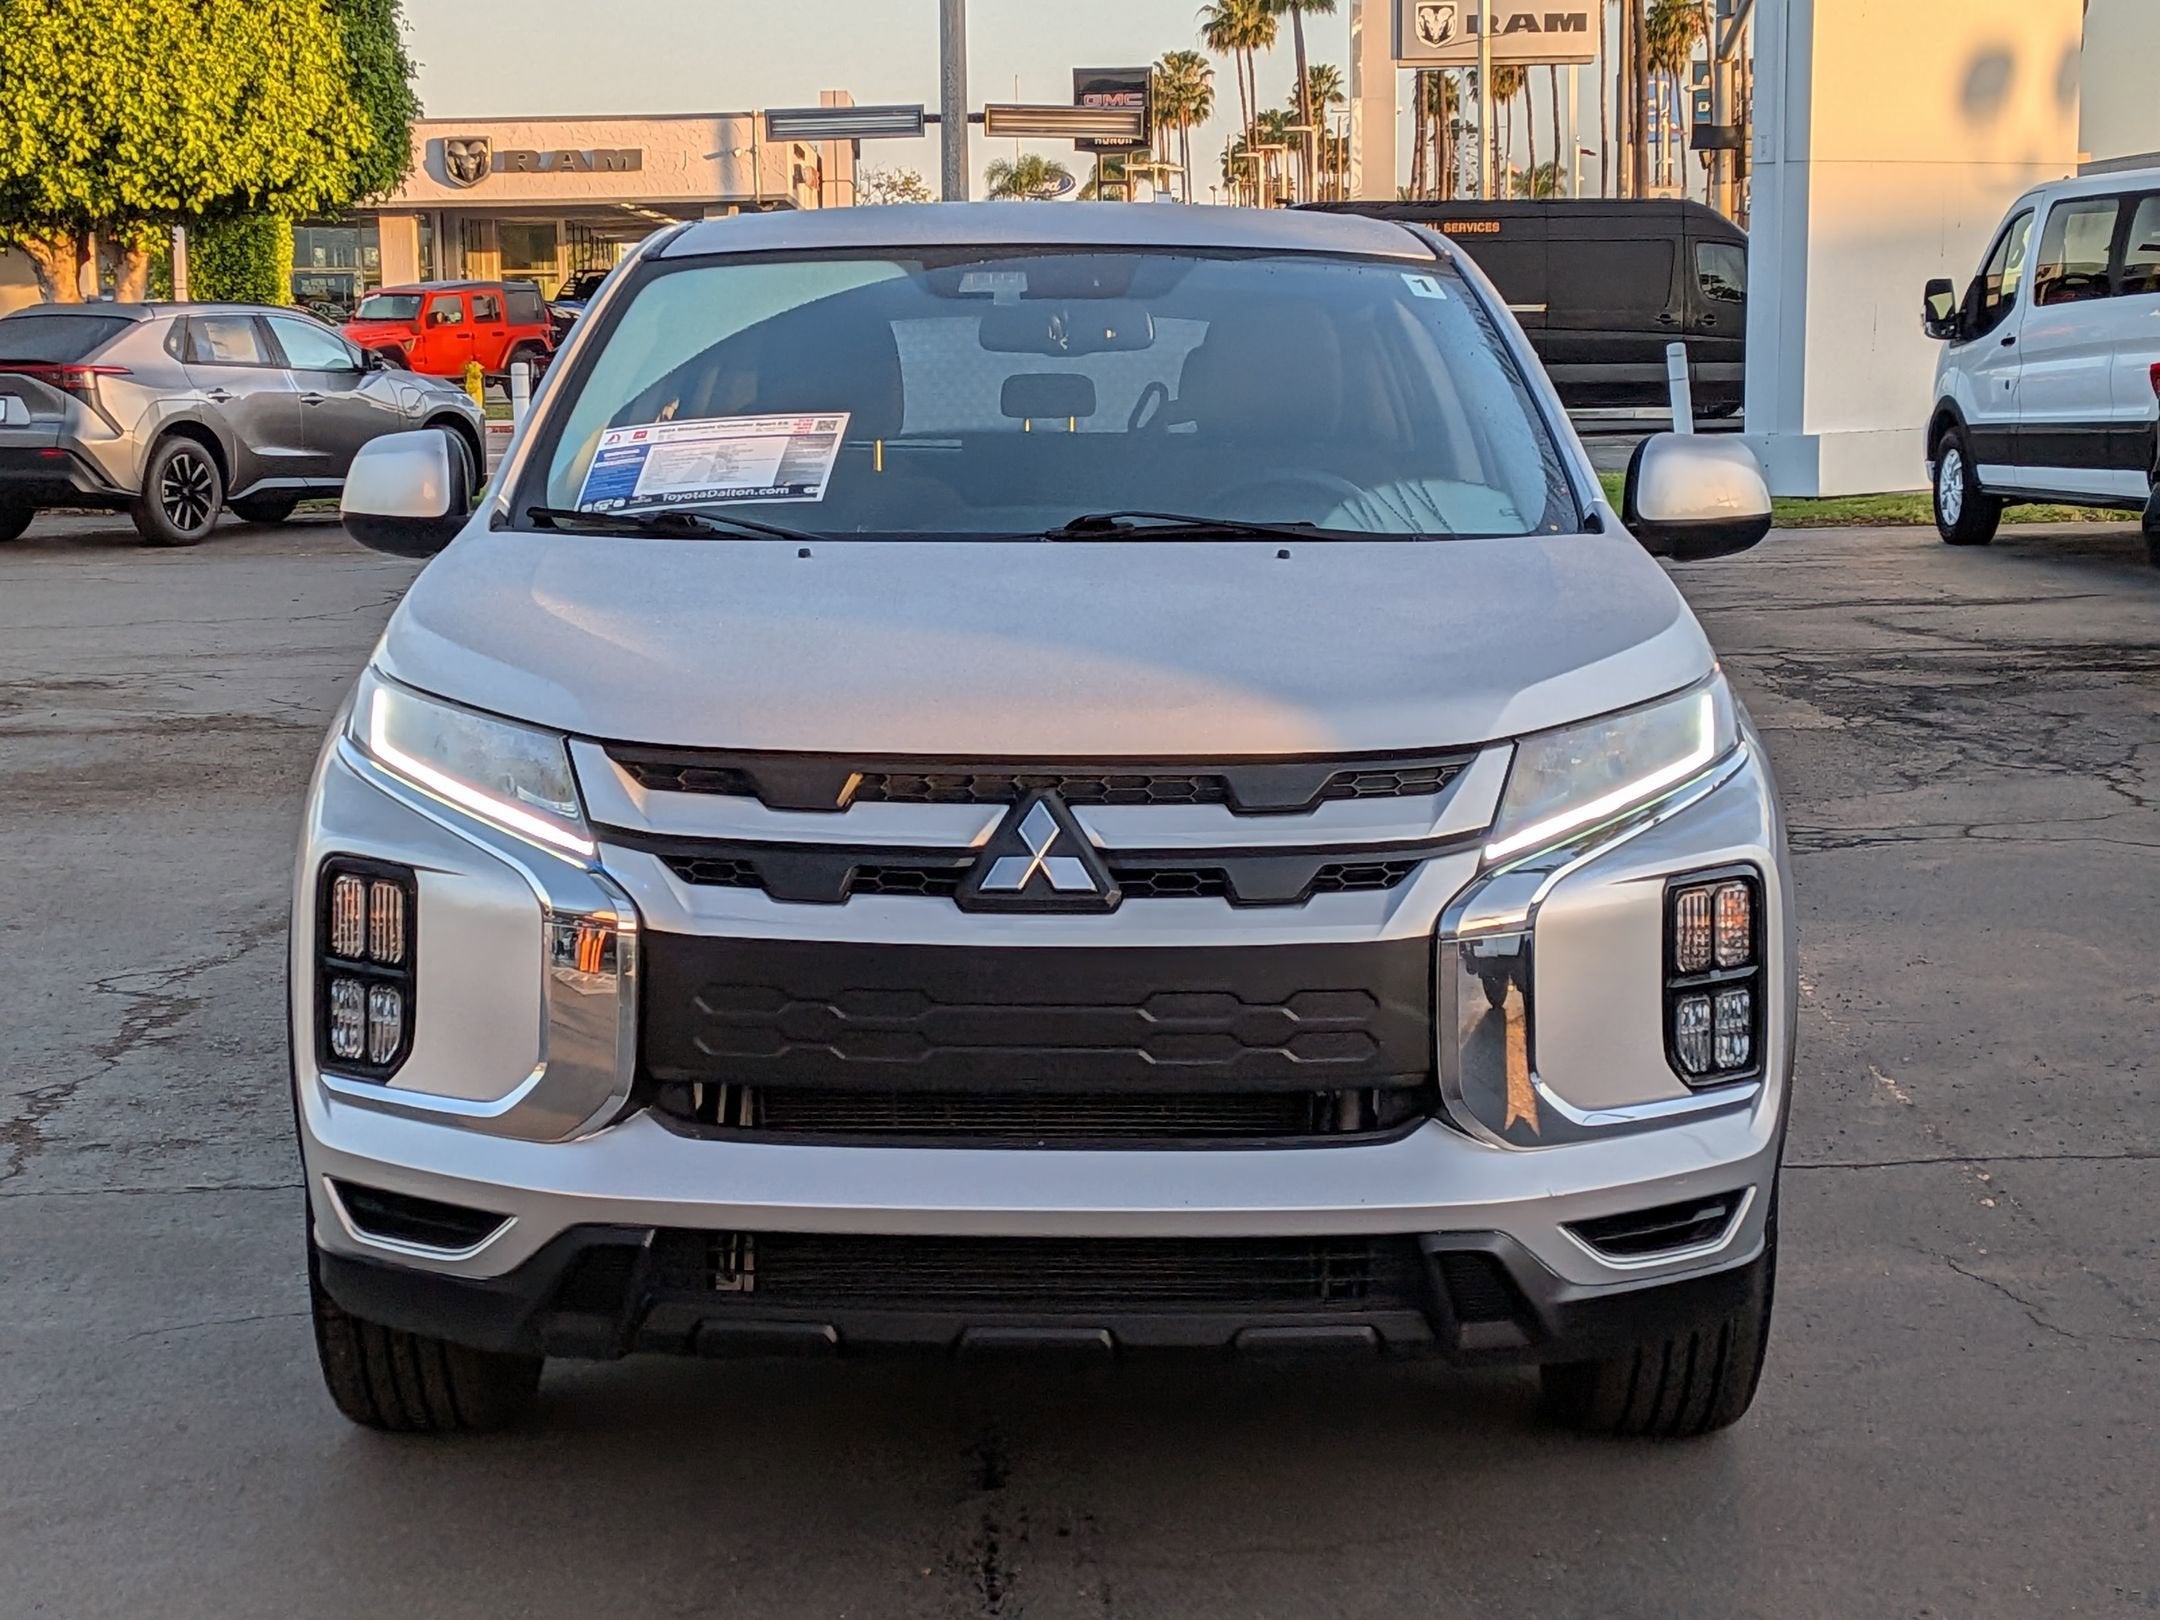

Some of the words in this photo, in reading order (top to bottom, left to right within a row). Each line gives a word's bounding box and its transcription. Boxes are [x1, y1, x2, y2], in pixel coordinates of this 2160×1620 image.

[1466, 13, 1587, 33] RAM
[1084, 93, 1143, 106] GMC
[503, 149, 643, 172] RAM
[1444, 222, 1500, 233] SERVICES
[662, 487, 790, 502] ToyotaDalton.com
